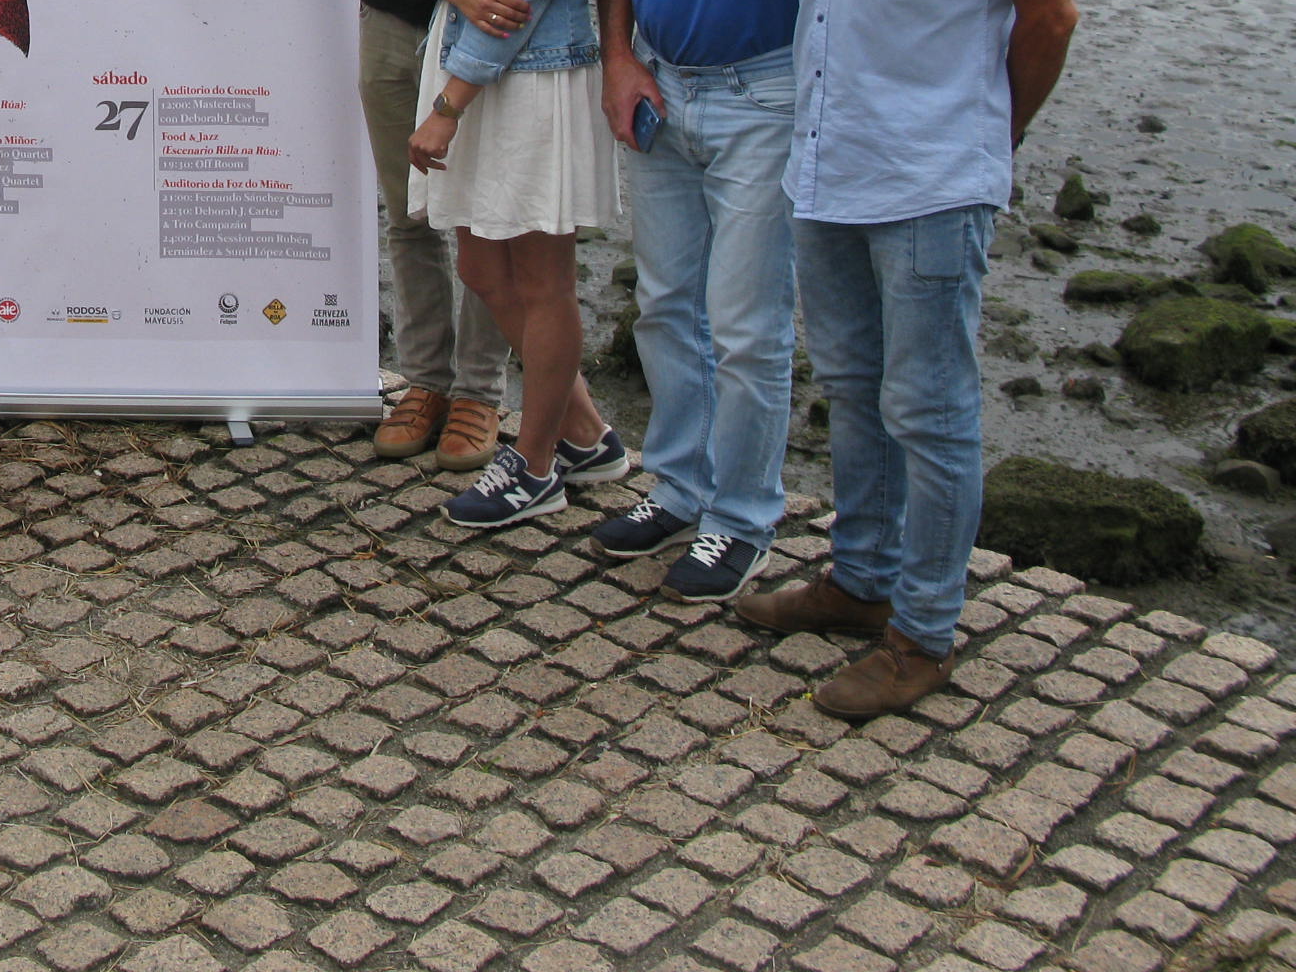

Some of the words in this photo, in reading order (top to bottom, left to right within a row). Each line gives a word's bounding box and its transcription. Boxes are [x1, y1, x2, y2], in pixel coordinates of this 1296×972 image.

[93, 71, 148, 85] sábado
[162, 86, 210, 95] Auditorio
[213, 85, 225, 95] do
[227, 87, 270, 96] Concello
[193, 100, 252, 109] Masterclass
[95, 100, 149, 140] 27
[181, 114, 223, 123] Deborah
[234, 114, 266, 123] Carter
[162, 132, 186, 141] Food
[197, 132, 219, 142] Jazz
[12, 150, 49, 160] Quartet
[163, 146, 213, 155] (Escenario
[216, 146, 238, 155] Rilla
[195, 159, 212, 168] Off
[214, 160, 244, 168] Room
[2, 176, 39, 187] Quartet
[162, 179, 210, 188] Auditorio
[212, 179, 224, 188] da
[226, 180, 242, 188] Foz
[245, 179, 257, 188] do
[195, 193, 241, 202] Fernando
[286, 195, 331, 204] Quinteto
[195, 207, 238, 216] Deborah
[248, 208, 279, 216] Carter
[217, 234, 253, 243] Session
[145, 307, 191, 315] FUNDACIÓN
[314, 309, 348, 317] CERVEZAS
[311, 319, 350, 327] ALHAMBRA
